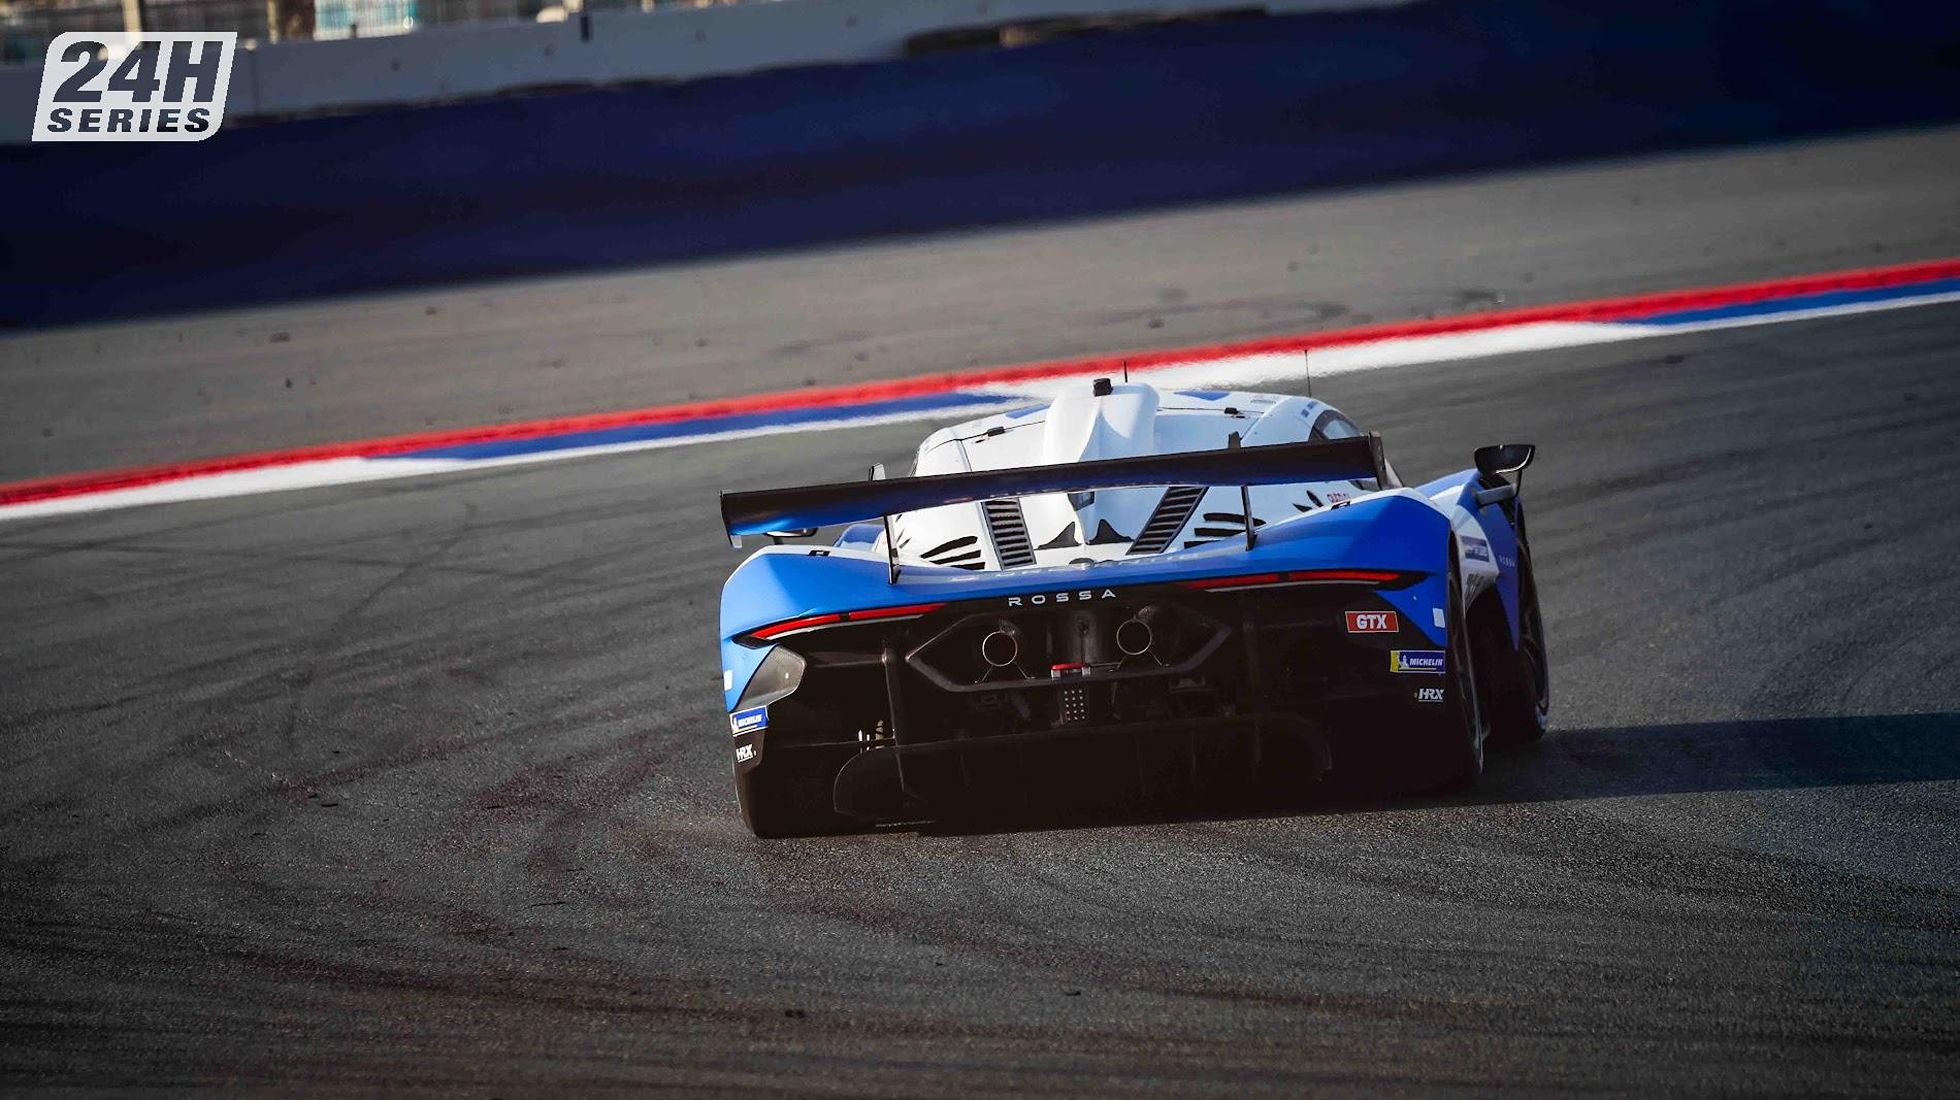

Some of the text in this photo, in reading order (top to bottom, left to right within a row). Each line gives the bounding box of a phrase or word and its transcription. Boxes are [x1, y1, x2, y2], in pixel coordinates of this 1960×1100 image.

[1008, 589, 1117, 607] ROSSA
[1356, 614, 1387, 629] GTX
[1409, 657, 1443, 666] MICHELIN
